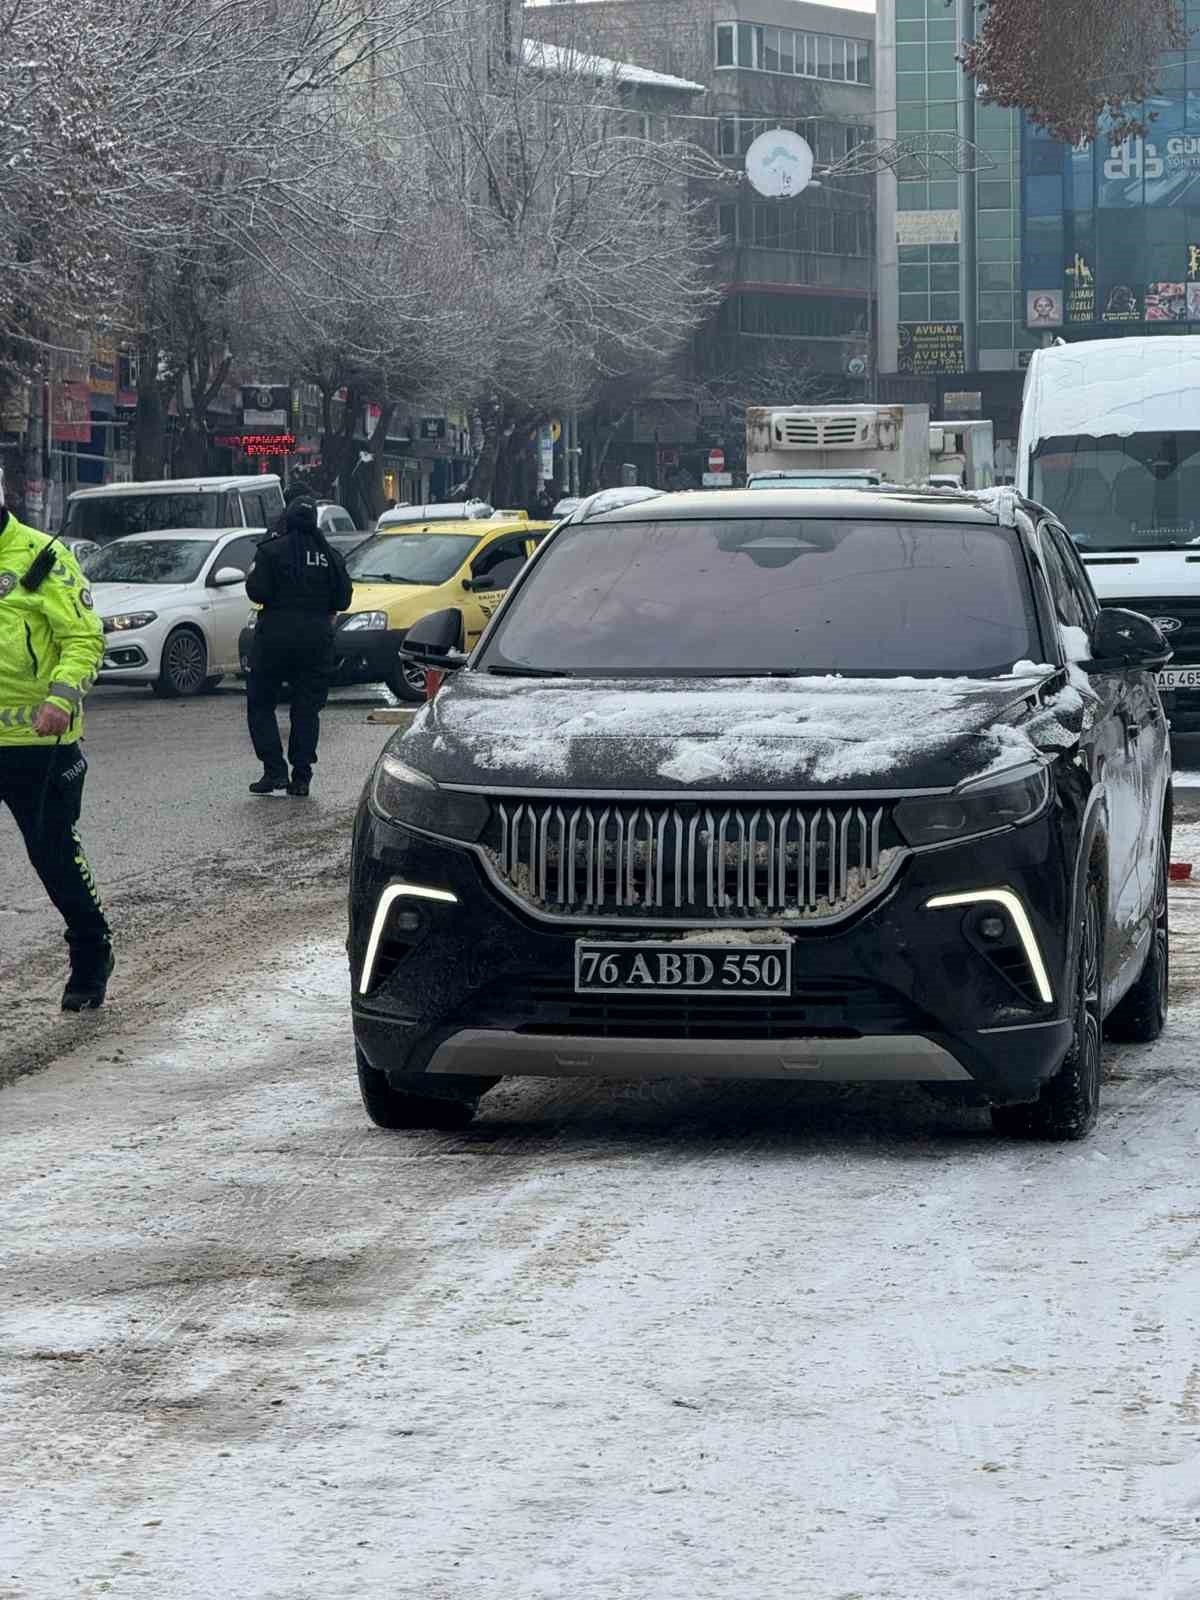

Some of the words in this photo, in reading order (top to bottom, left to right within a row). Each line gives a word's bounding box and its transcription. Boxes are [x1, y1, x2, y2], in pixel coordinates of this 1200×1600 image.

[915, 325, 959, 335] AVUKAT
[914, 350, 963, 360] AVUKAT
[306, 551, 329, 567] LİS
[582, 952, 621, 984] 76
[625, 952, 715, 985] ABD
[721, 954, 782, 986] 550
